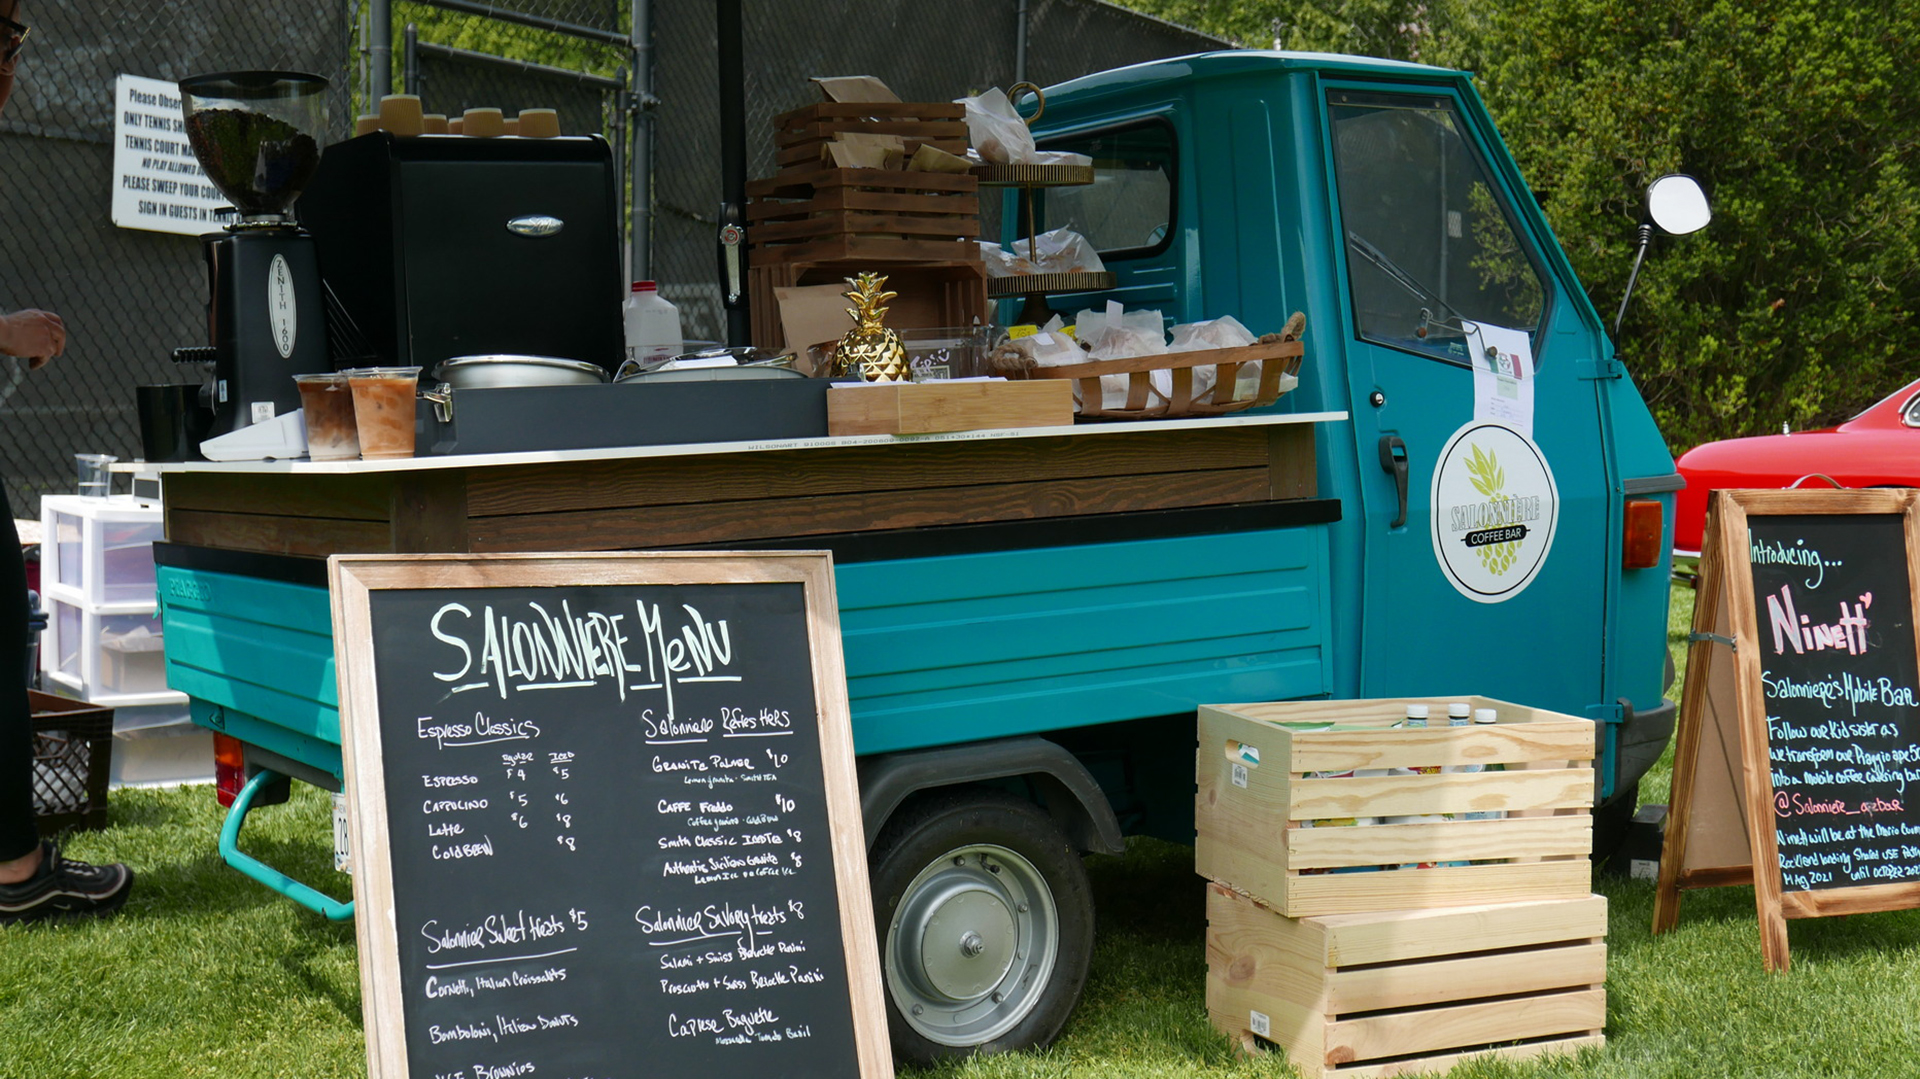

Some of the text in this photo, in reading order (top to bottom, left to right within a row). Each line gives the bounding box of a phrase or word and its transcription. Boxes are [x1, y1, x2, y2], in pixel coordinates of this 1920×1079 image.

[129, 88, 157, 106] Please
[124, 111, 142, 127] ONLY
[145, 114, 171, 131] TENNIS
[125, 134, 152, 152] TENNIS
[154, 137, 179, 155] COURT
[142, 157, 151, 168] NO
[152, 159, 167, 170] PLAY
[167, 161, 196, 175] ALLOWED
[122, 174, 150, 191] PLEASE
[152, 179, 178, 195] SWEEP
[180, 183, 199, 197] YOUR
[138, 199, 157, 215] SIGN
[159, 203, 167, 216] IN
[169, 204, 197, 220] GUESTS
[199, 208, 207, 221] IN
[276, 260, 290, 351] ZENITH 1600
[1470, 526, 1523, 546] COFFEE BAR
[417, 710, 541, 750] Espresso Classics
[1766, 716, 1808, 741] Follow
[1880, 723, 1899, 738] as
[428, 822, 465, 837] Latte
[1808, 871, 1833, 884] 2021
[484, 909, 526, 945] Sweet
[568, 907, 589, 931] $5
[695, 955, 704, 965] +
[713, 976, 721, 989] +
